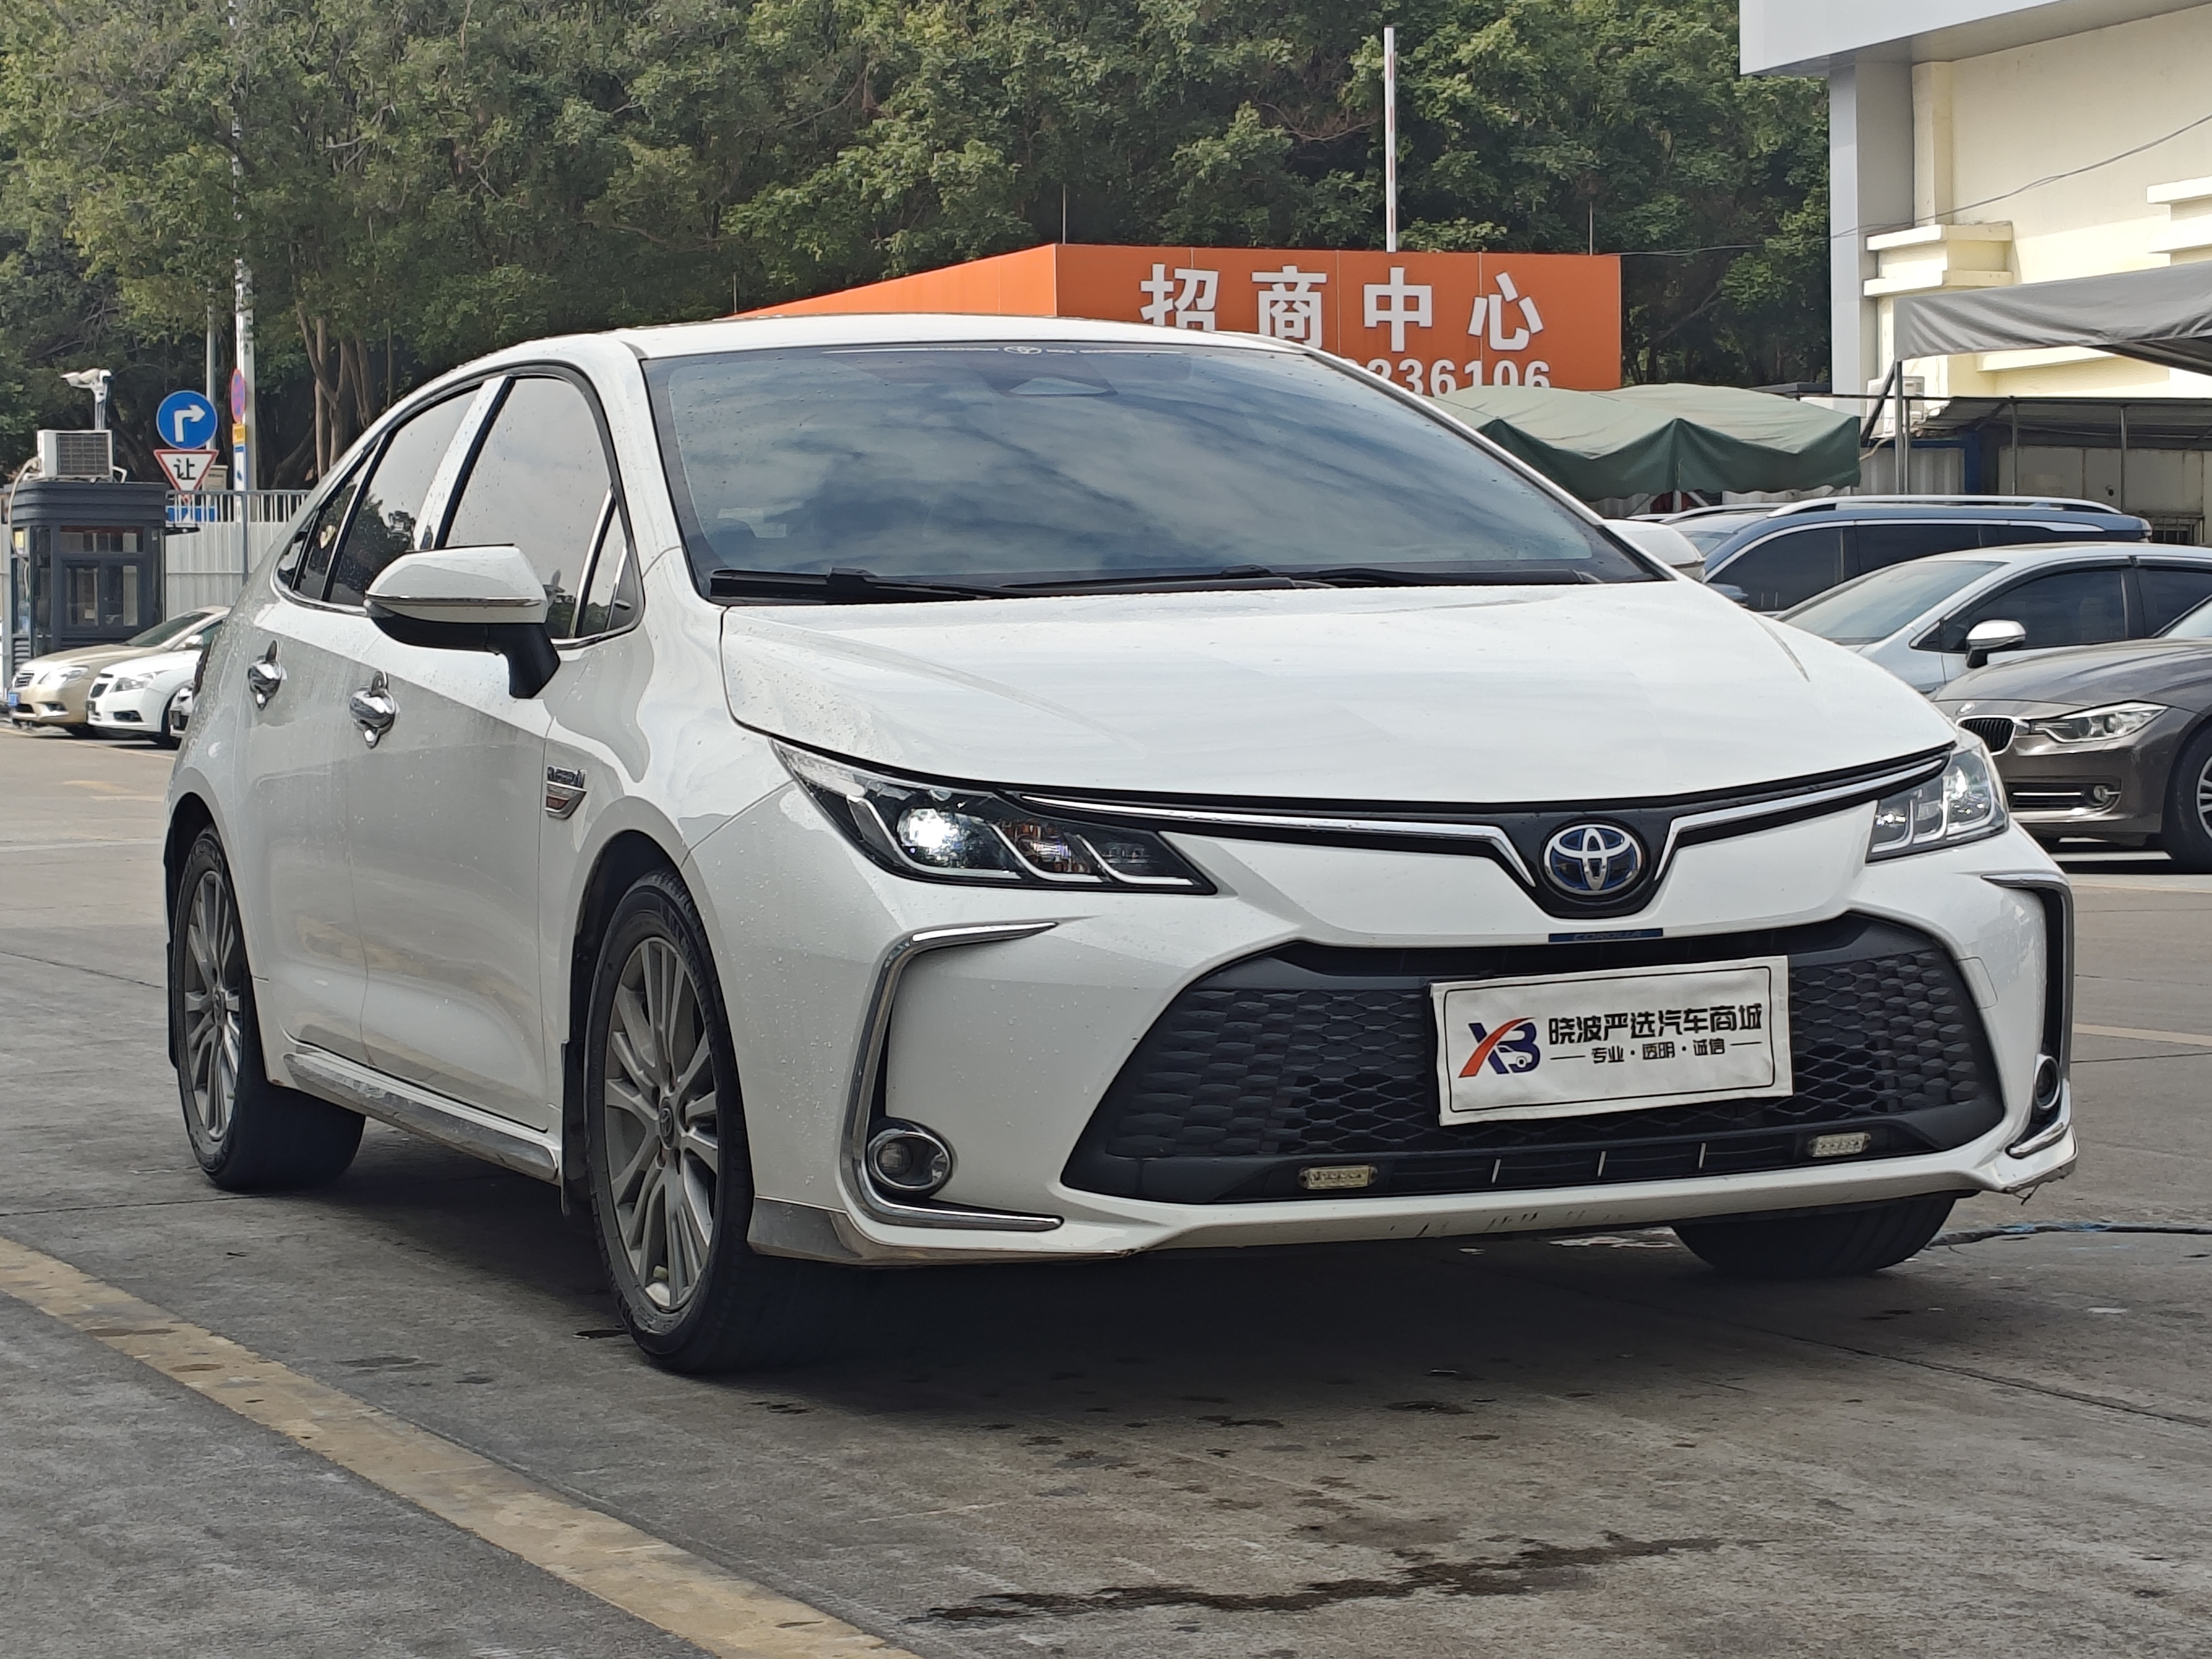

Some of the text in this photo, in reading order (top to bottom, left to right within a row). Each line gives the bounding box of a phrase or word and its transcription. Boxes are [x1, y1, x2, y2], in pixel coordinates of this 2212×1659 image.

[1140, 263, 1543, 353] 招商中心
[173, 457, 196, 480] 让
[1548, 1003, 1762, 1045] 晓波严选汽车商城
